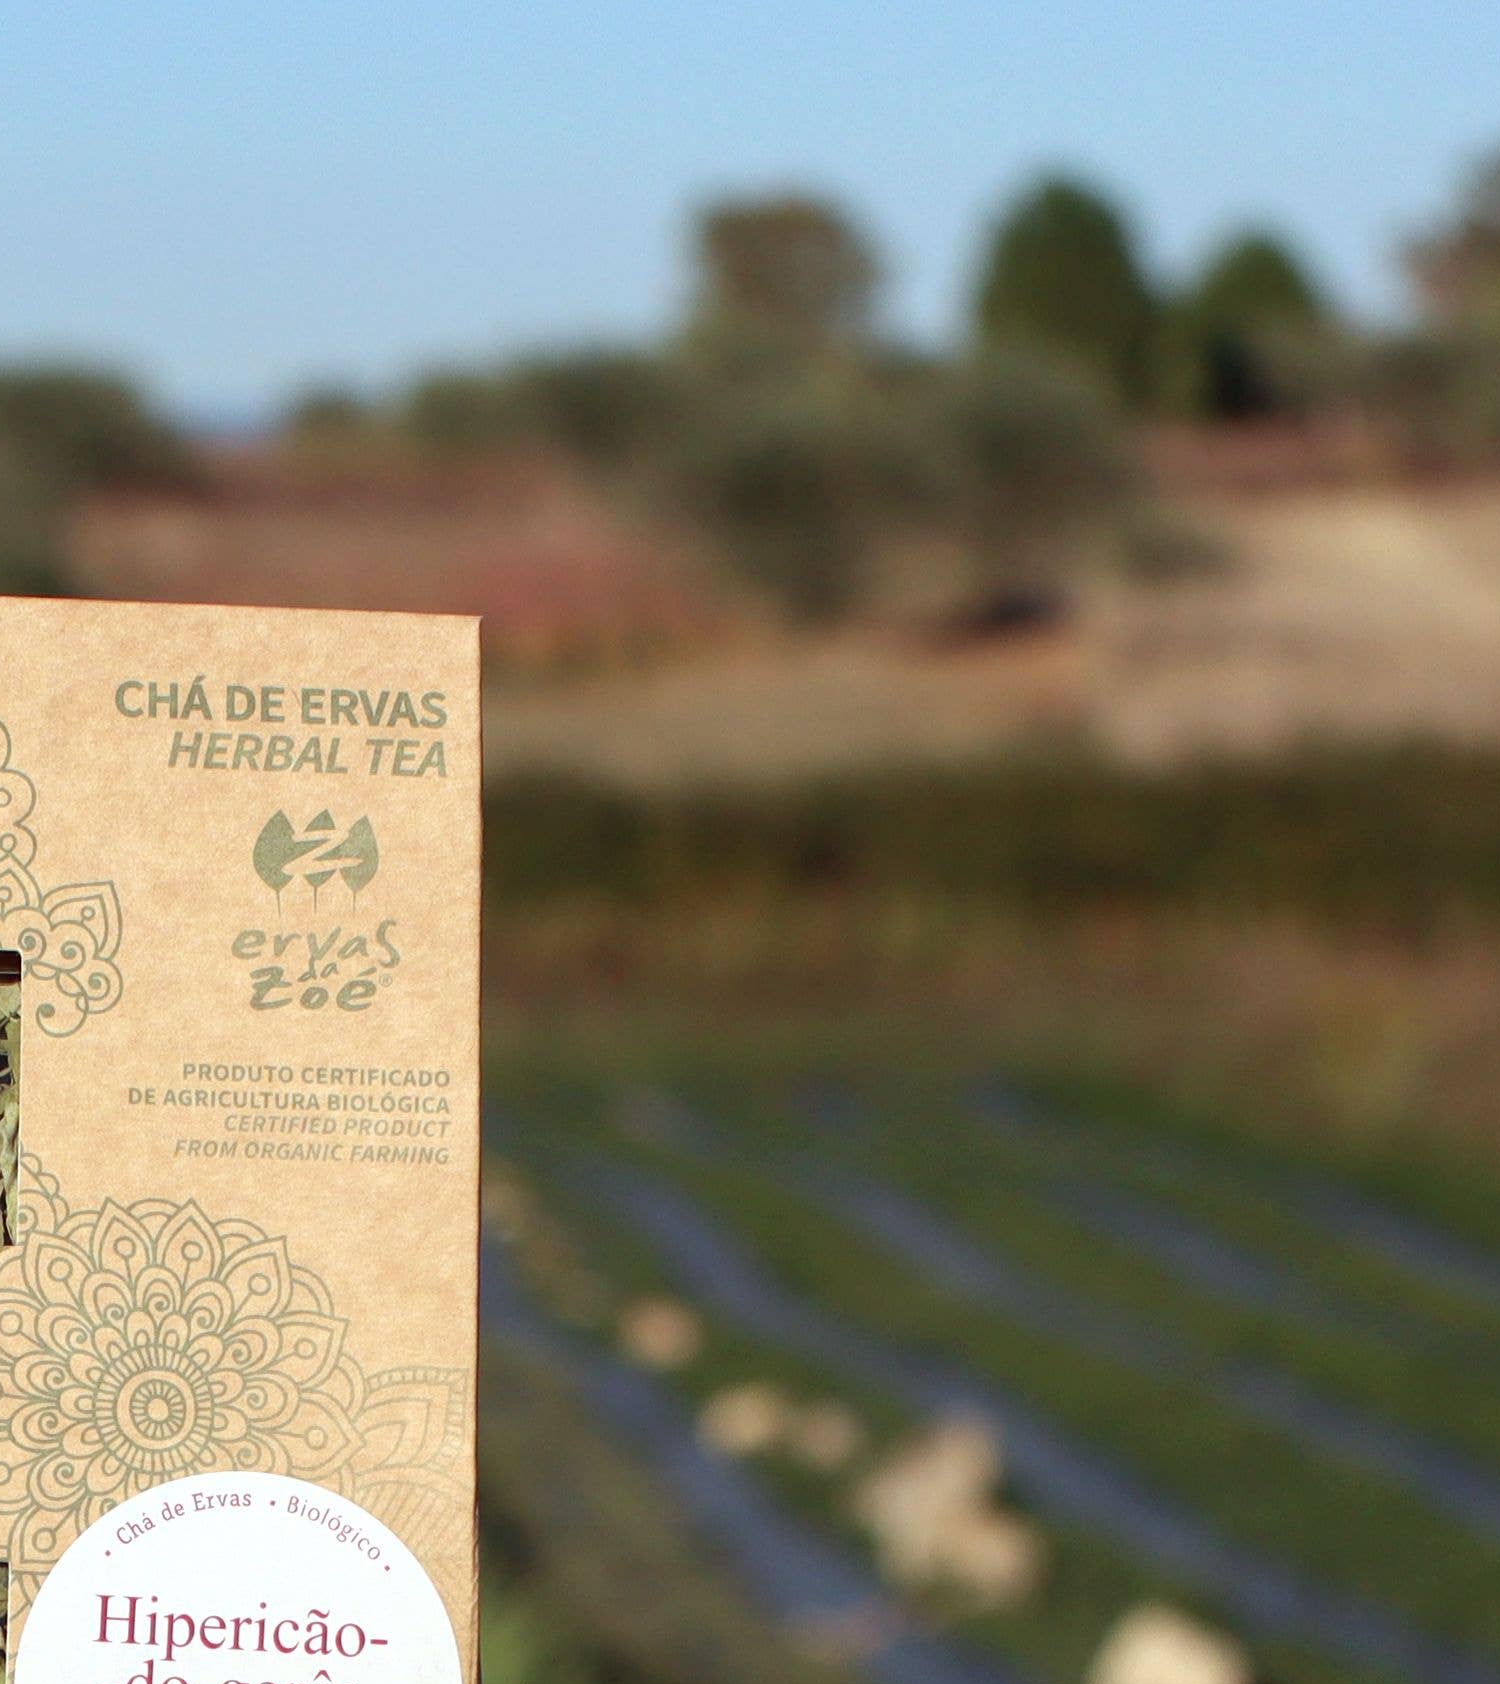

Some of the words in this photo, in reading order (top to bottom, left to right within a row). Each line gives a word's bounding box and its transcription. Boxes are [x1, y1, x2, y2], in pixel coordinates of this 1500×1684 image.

[115, 674, 213, 721] CHÁ
[225, 685, 285, 724] DE
[300, 688, 448, 728] ERVAS
[167, 731, 349, 775] HERBAL
[364, 738, 448, 777] TEA
[298, 958, 339, 983] da
[183, 1063, 294, 1084] PRODUTO
[301, 1067, 450, 1087] CERTIFICADO
[128, 1087, 156, 1105] DE
[162, 1089, 320, 1111] AGRICULTURA
[327, 1092, 450, 1114] BIOLÓGICA
[224, 1115, 337, 1135] CERTIFIED
[343, 1118, 450, 1139] PRODUCT
[173, 1140, 238, 1158] FROM
[244, 1141, 344, 1162] ORGANIC
[350, 1144, 449, 1165] FARMING
[116, 1512, 156, 1545] Chá
[161, 1502, 185, 1522] de
[191, 1492, 252, 1512] Ervas
[286, 1495, 381, 1560] Biológico
[92, 1593, 389, 1661] Hipericão-
